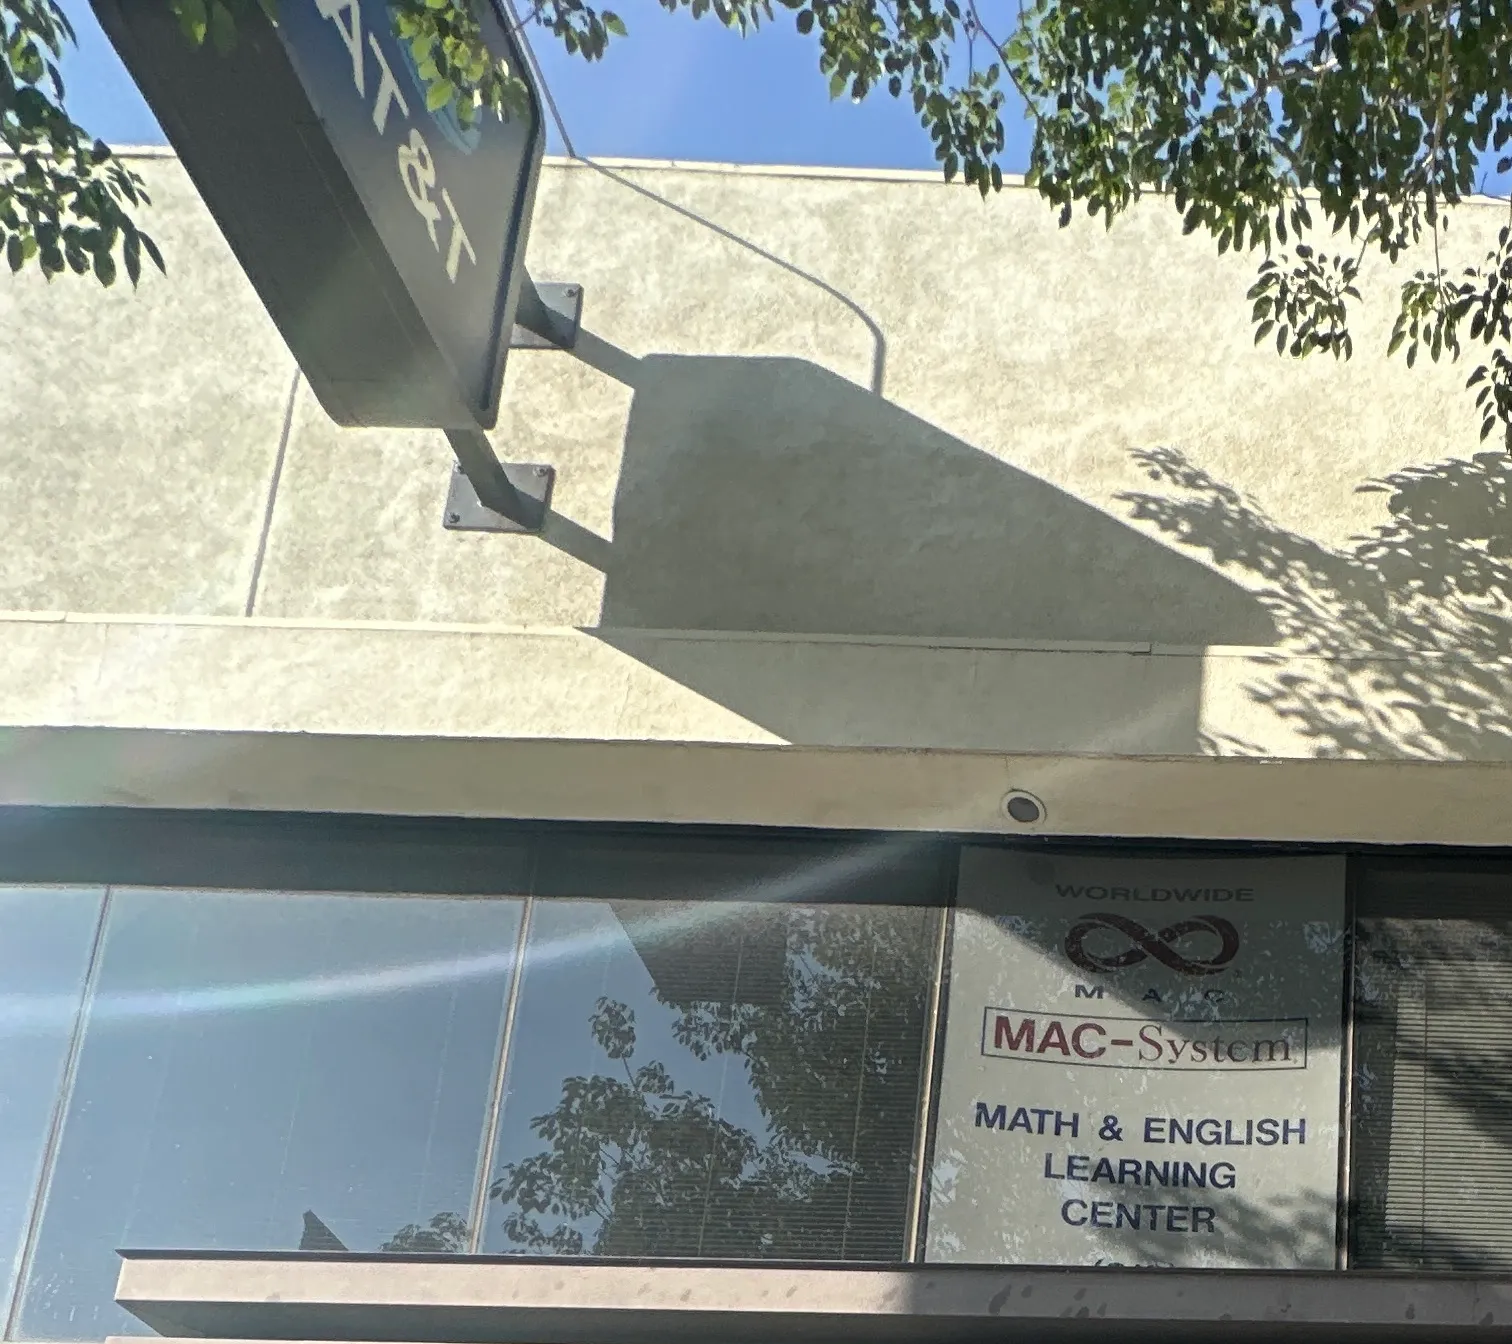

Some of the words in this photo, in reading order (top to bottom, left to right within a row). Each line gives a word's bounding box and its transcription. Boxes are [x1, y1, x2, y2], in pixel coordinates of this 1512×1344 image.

[314, 0, 477, 284] AT&T
[1056, 884, 1255, 902] WORLDWIDE
[974, 1101, 1080, 1138] MATH
[1098, 1115, 1124, 1142] &
[1143, 1117, 1307, 1146] ENGLISH
[1044, 1152, 1237, 1189] LEARNING
[1060, 1199, 1216, 1233] CENTER
